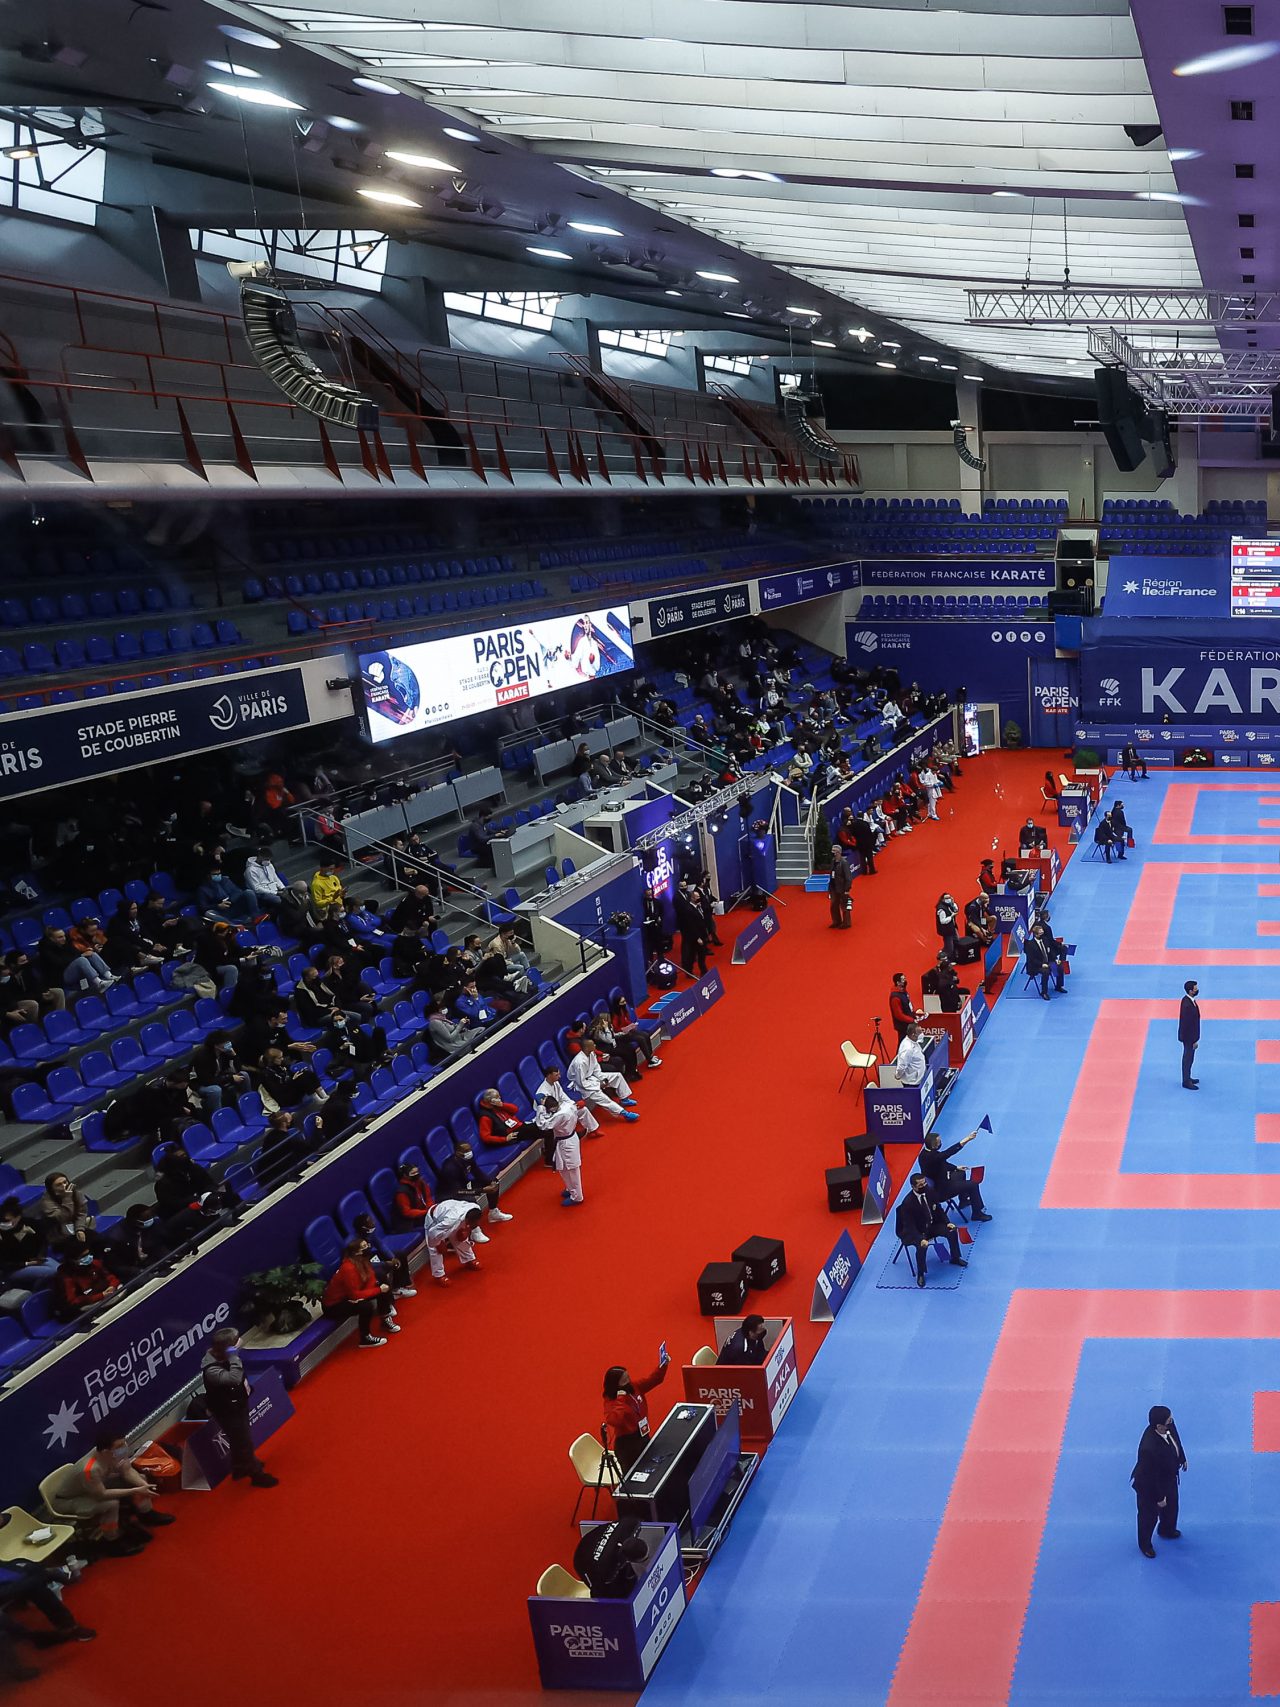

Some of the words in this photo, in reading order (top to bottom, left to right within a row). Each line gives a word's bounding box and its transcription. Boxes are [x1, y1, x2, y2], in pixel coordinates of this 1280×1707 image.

[931, 571, 986, 579] FRANÇAISE
[991, 568, 1046, 580] KARATÉ
[1142, 578, 1182, 588] Région
[667, 610, 684, 624] PARIS
[473, 629, 525, 663] PARIS
[490, 652, 541, 687] OPEN
[237, 693, 259, 702] VILLE
[497, 687, 529, 701] KARATE
[1034, 686, 1069, 697] PARIS
[240, 695, 288, 722] PARIS
[1041, 696, 1079, 708] OPEN
[1099, 697, 1121, 706] FFK
[77, 720, 125, 741] STADE
[128, 709, 178, 732] PIERRE
[81, 743, 102, 758] DE
[104, 725, 181, 753] COUBERTIN
[0, 747, 43, 777] RIS
[873, 1104, 903, 1113] PARIS
[880, 1111, 911, 1121] OPEN
[828, 1253, 844, 1283] PARIS
[835, 1257, 851, 1286] OPEN
[83, 1327, 164, 1397] Région
[774, 1362, 791, 1398] AKA
[698, 1388, 742, 1398] PARIS
[651, 1586, 668, 1626] AO
[549, 1624, 603, 1638] PARIS
[564, 1636, 619, 1651] OPEN
